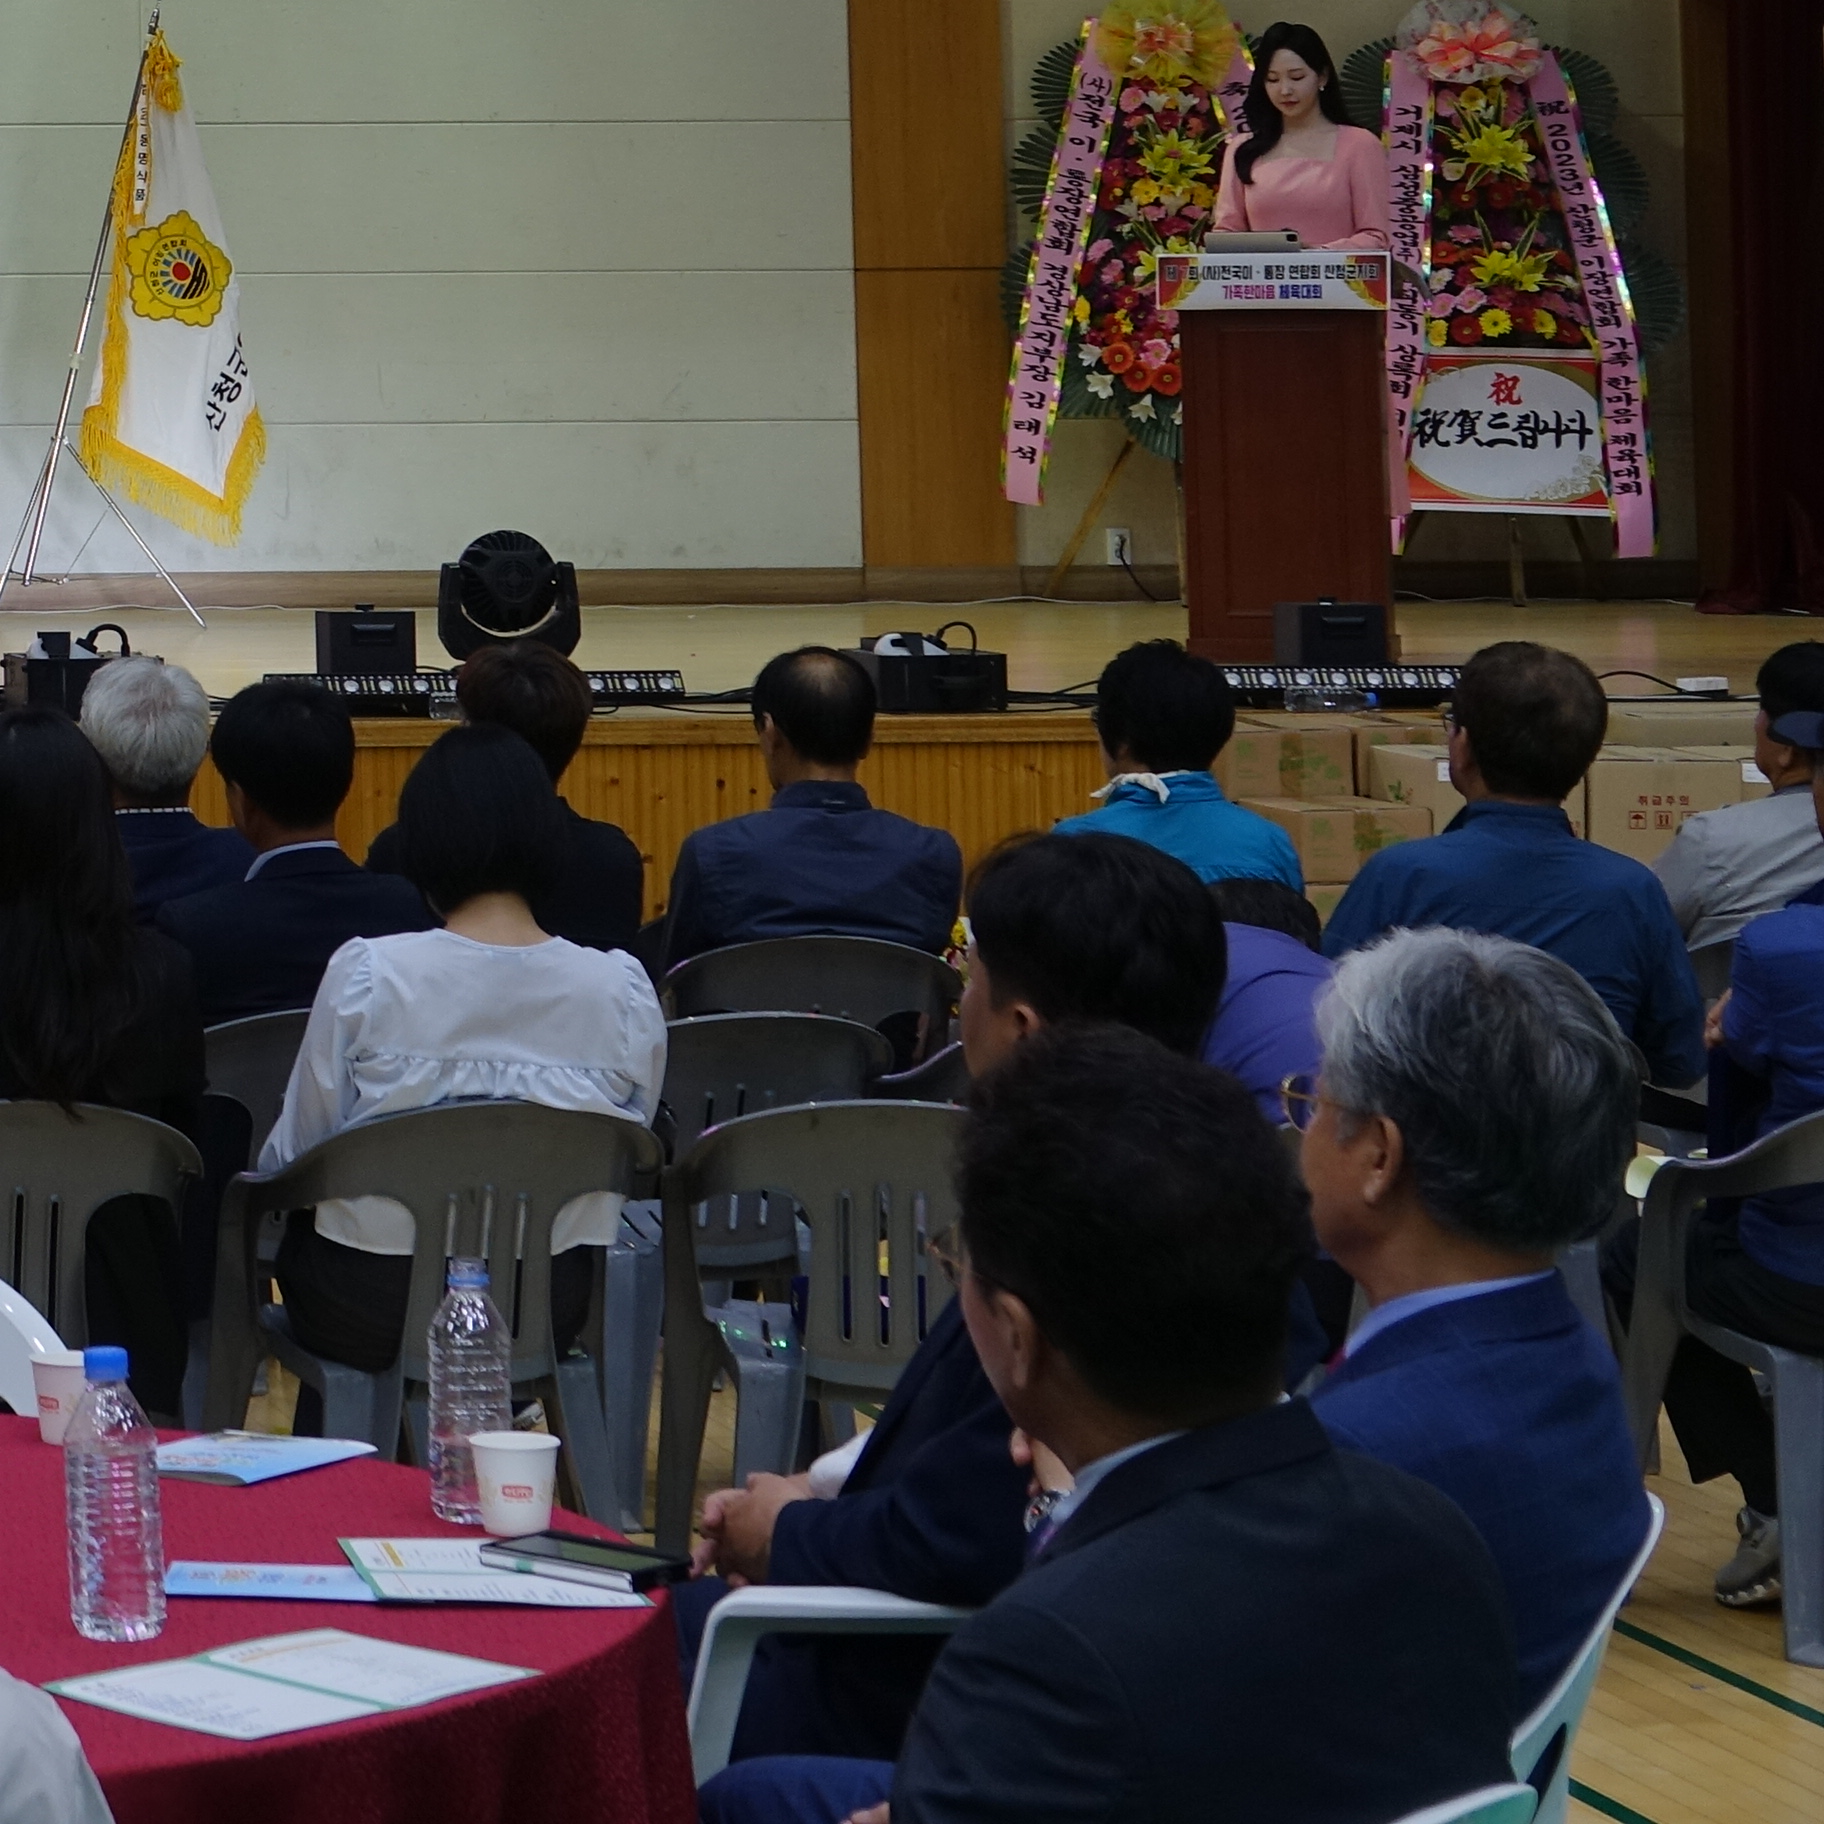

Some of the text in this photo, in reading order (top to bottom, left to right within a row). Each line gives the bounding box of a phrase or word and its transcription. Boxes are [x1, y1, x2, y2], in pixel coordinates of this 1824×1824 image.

[1546, 124, 1585, 197] 2023년
[1566, 204, 1603, 248] 산청군
[1222, 284, 1323, 300] 가족한마음 체육대회
[1289, 264, 1321, 279] 연합회
[1581, 257, 1622, 329] 이장연합회
[1602, 338, 1634, 367] 가족
[1486, 371, 1523, 406] 祝
[1604, 376, 1639, 425] 한마음
[1610, 433, 1644, 497] 체육대회
